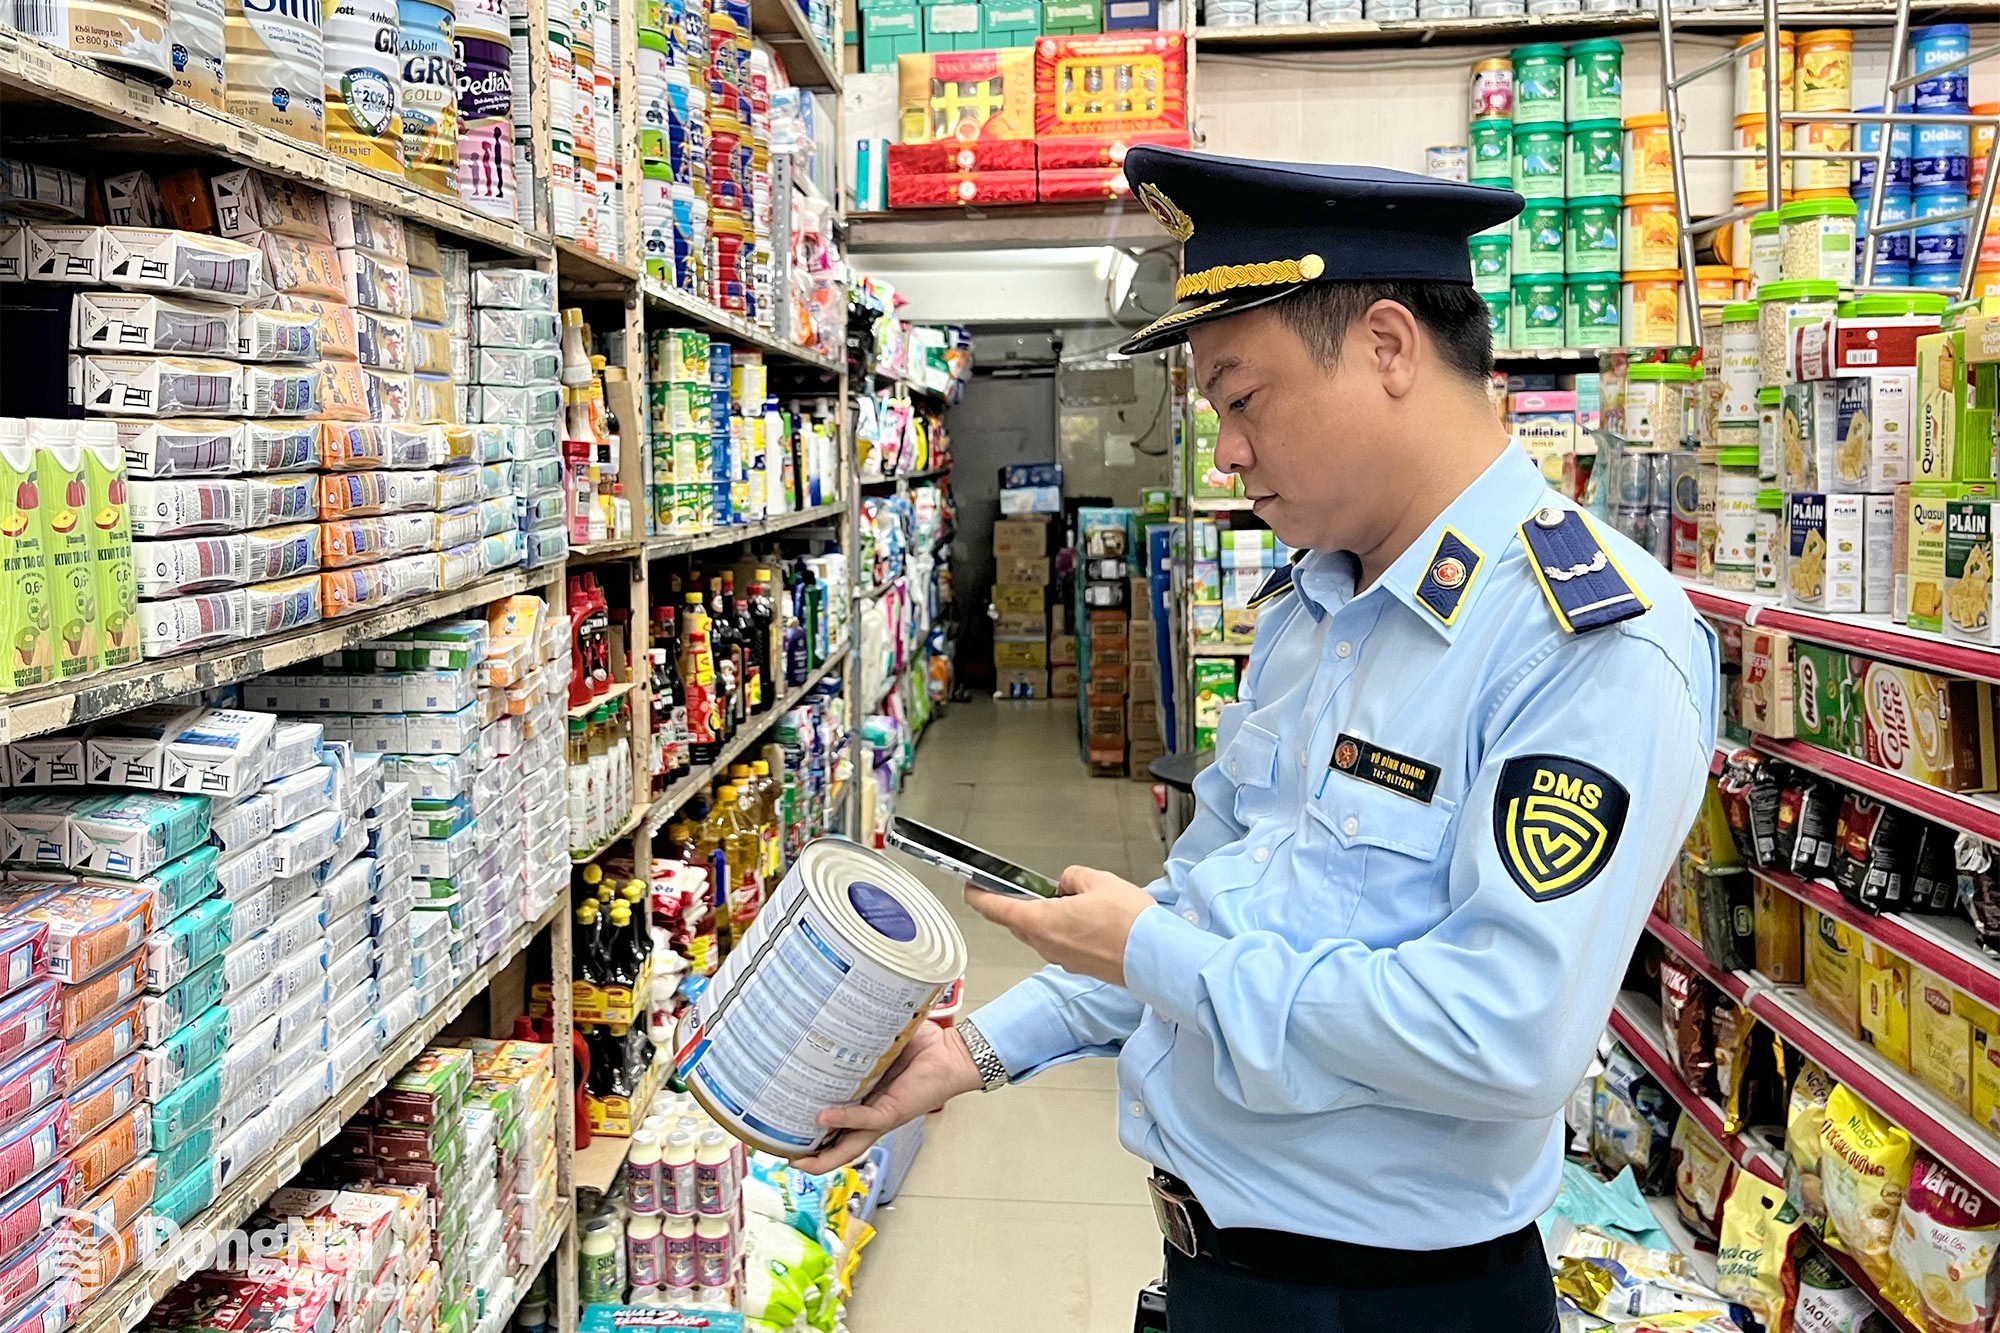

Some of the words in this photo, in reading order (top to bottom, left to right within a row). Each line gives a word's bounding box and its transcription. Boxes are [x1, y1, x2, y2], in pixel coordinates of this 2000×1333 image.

[86, 35, 102, 45] 800
[402, 40, 438, 52] Abbott
[402, 88, 442, 101] GOLD
[1920, 130, 1963, 143] Dielac
[358, 148, 371, 156] NET
[1519, 428, 1567, 437] Ridielac
[1922, 404, 1933, 474] Quasure
[1792, 504, 1824, 520] PLAIN
[1949, 513, 1986, 533] PLAIN
[1803, 664, 1815, 724] MILO
[1371, 751, 1381, 764] VŨ
[1381, 755, 1399, 771] ĐÌNH
[1399, 762, 1426, 781] QUANG
[1532, 769, 1604, 810] DMS
